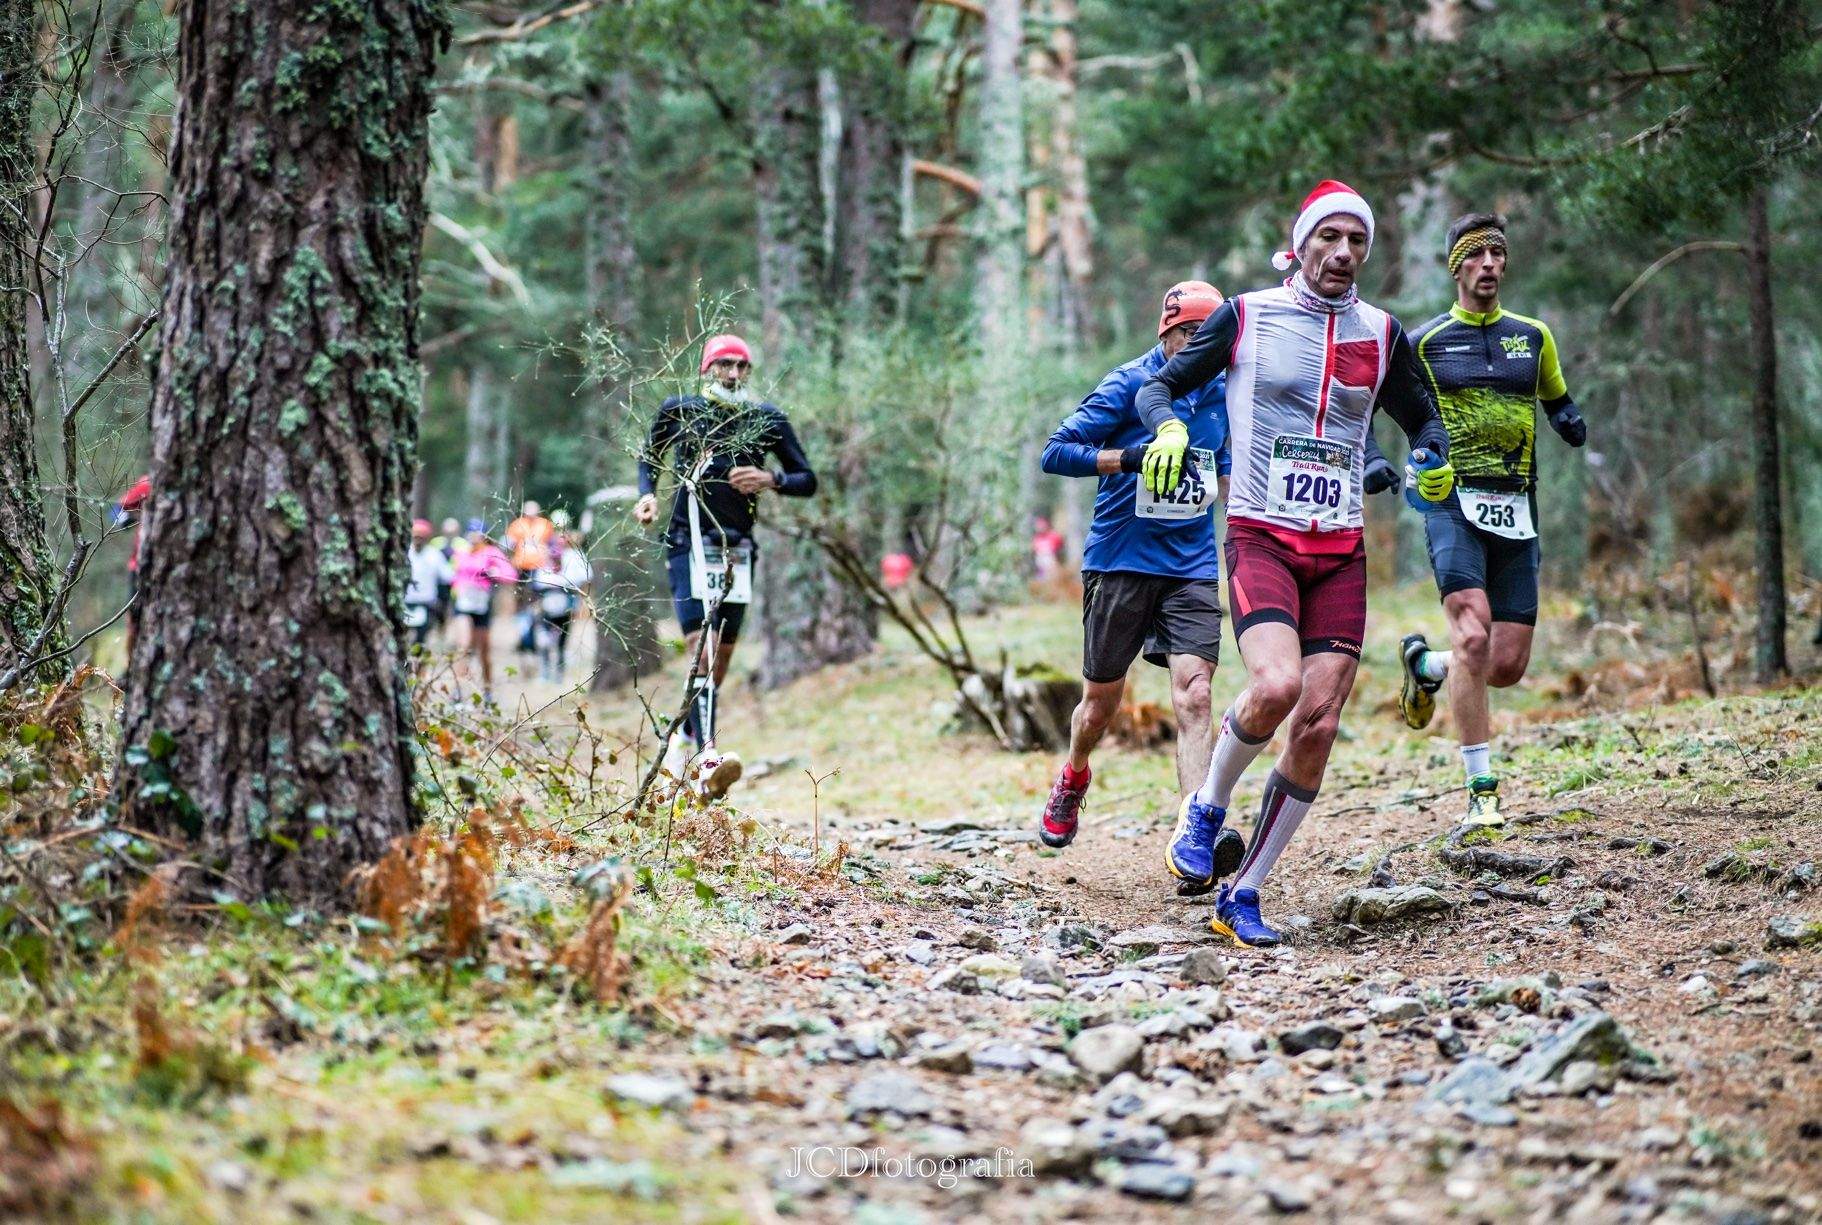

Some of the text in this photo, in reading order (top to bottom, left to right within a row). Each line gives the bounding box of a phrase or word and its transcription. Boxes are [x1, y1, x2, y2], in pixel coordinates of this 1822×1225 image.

[1278, 438, 1308, 447] CARRERA
[1317, 442, 1341, 453] NAVIDAD
[1283, 472, 1342, 508] 1203
[1476, 503, 1515, 527] 253
